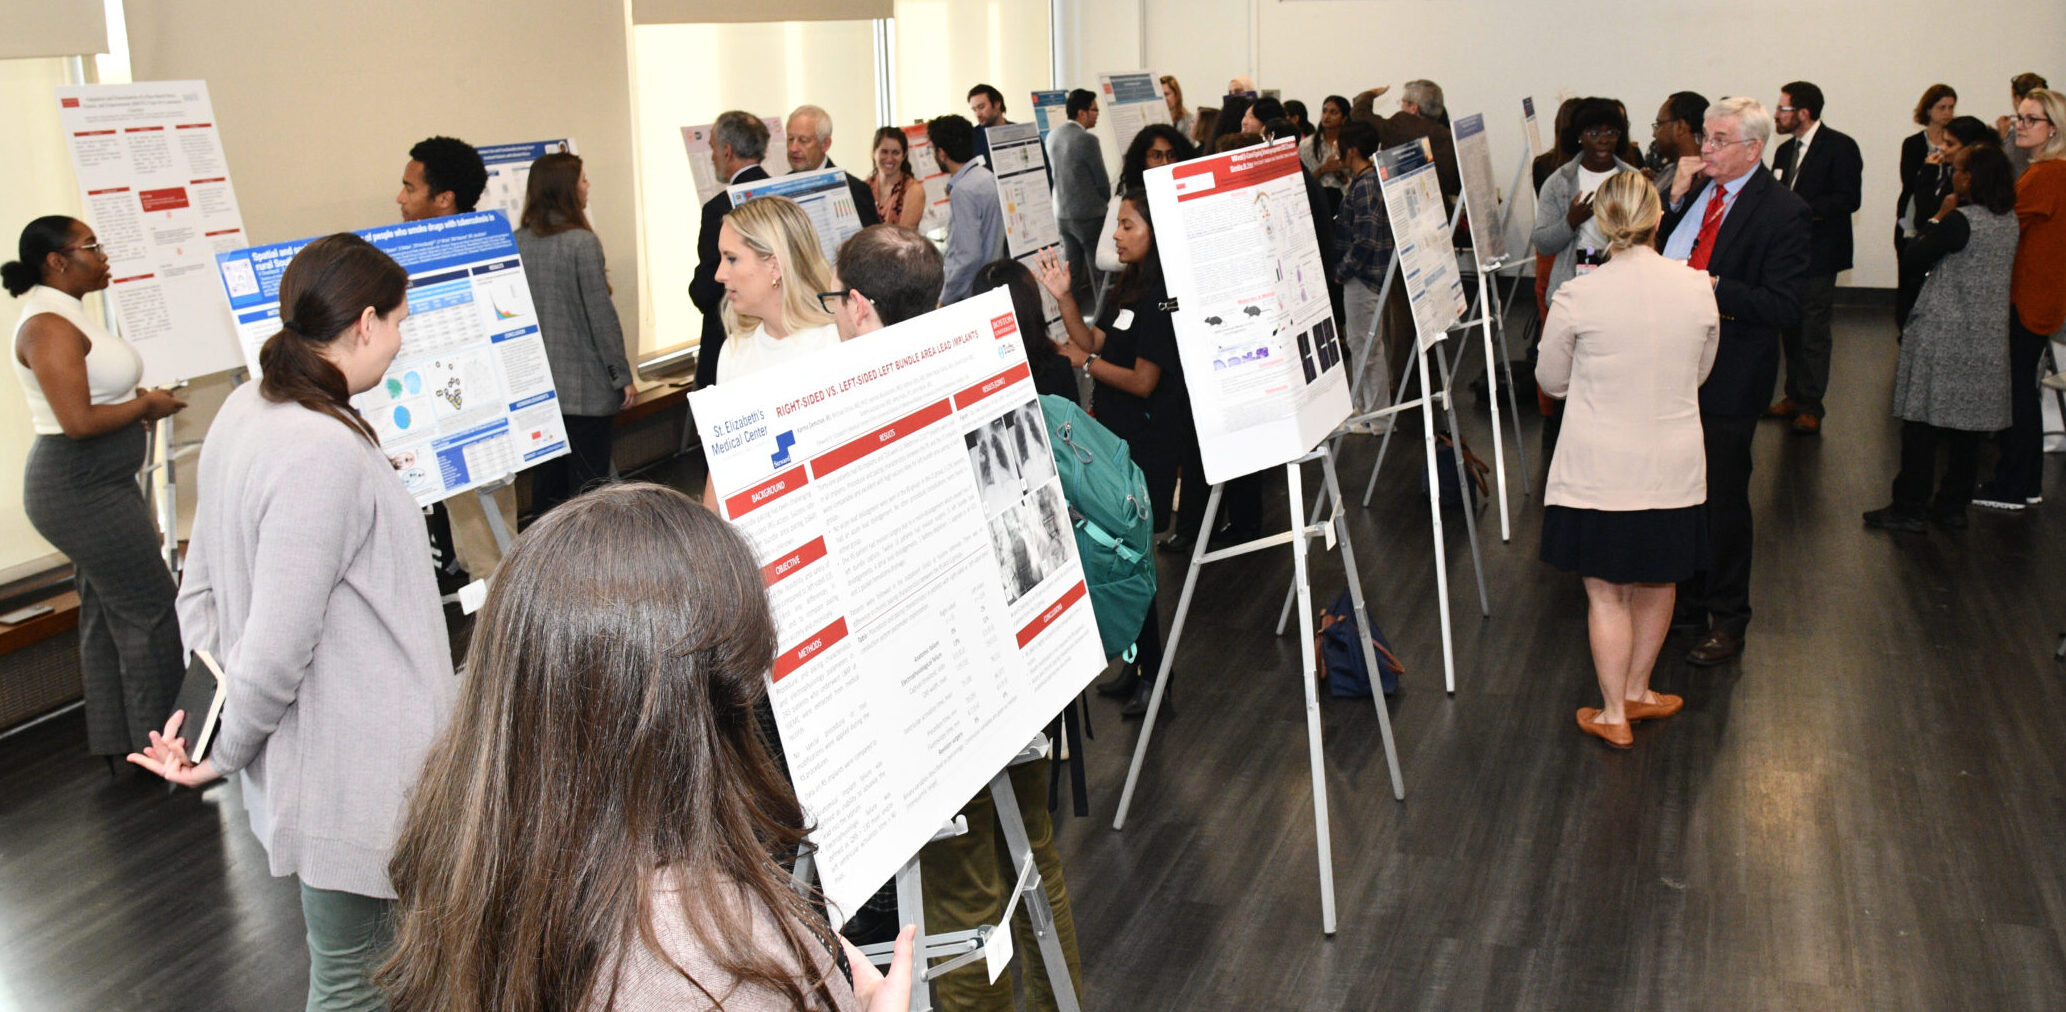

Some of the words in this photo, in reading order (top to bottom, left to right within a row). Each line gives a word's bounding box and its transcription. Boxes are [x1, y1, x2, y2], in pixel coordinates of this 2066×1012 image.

[252, 248, 278, 262] Spatial
[279, 246, 293, 256] and
[373, 229, 394, 242] people
[394, 227, 408, 236] who
[408, 225, 427, 234] smoke
[428, 222, 444, 232] drugs
[255, 260, 274, 270] rural
[992, 314, 1012, 328] BOSTON
[776, 390, 824, 417] RIGHT-SIDED
[826, 384, 838, 397] VS.
[838, 369, 876, 392] LEFT-SIDED
[878, 362, 894, 376] LEFT
[895, 352, 919, 369] BUNDLE
[920, 345, 936, 359] AREA
[936, 340, 951, 353] LEAD
[951, 329, 978, 347] IMPLANTS
[713, 423, 725, 438] St.
[724, 408, 764, 432] Elizabeth's
[711, 434, 743, 456] Medical
[744, 423, 768, 443] Center
[879, 428, 895, 442] RESULTS
[751, 481, 785, 502] BACKGROUND
[775, 555, 799, 574] OBJECTIVE
[798, 638, 821, 659] METHODS
